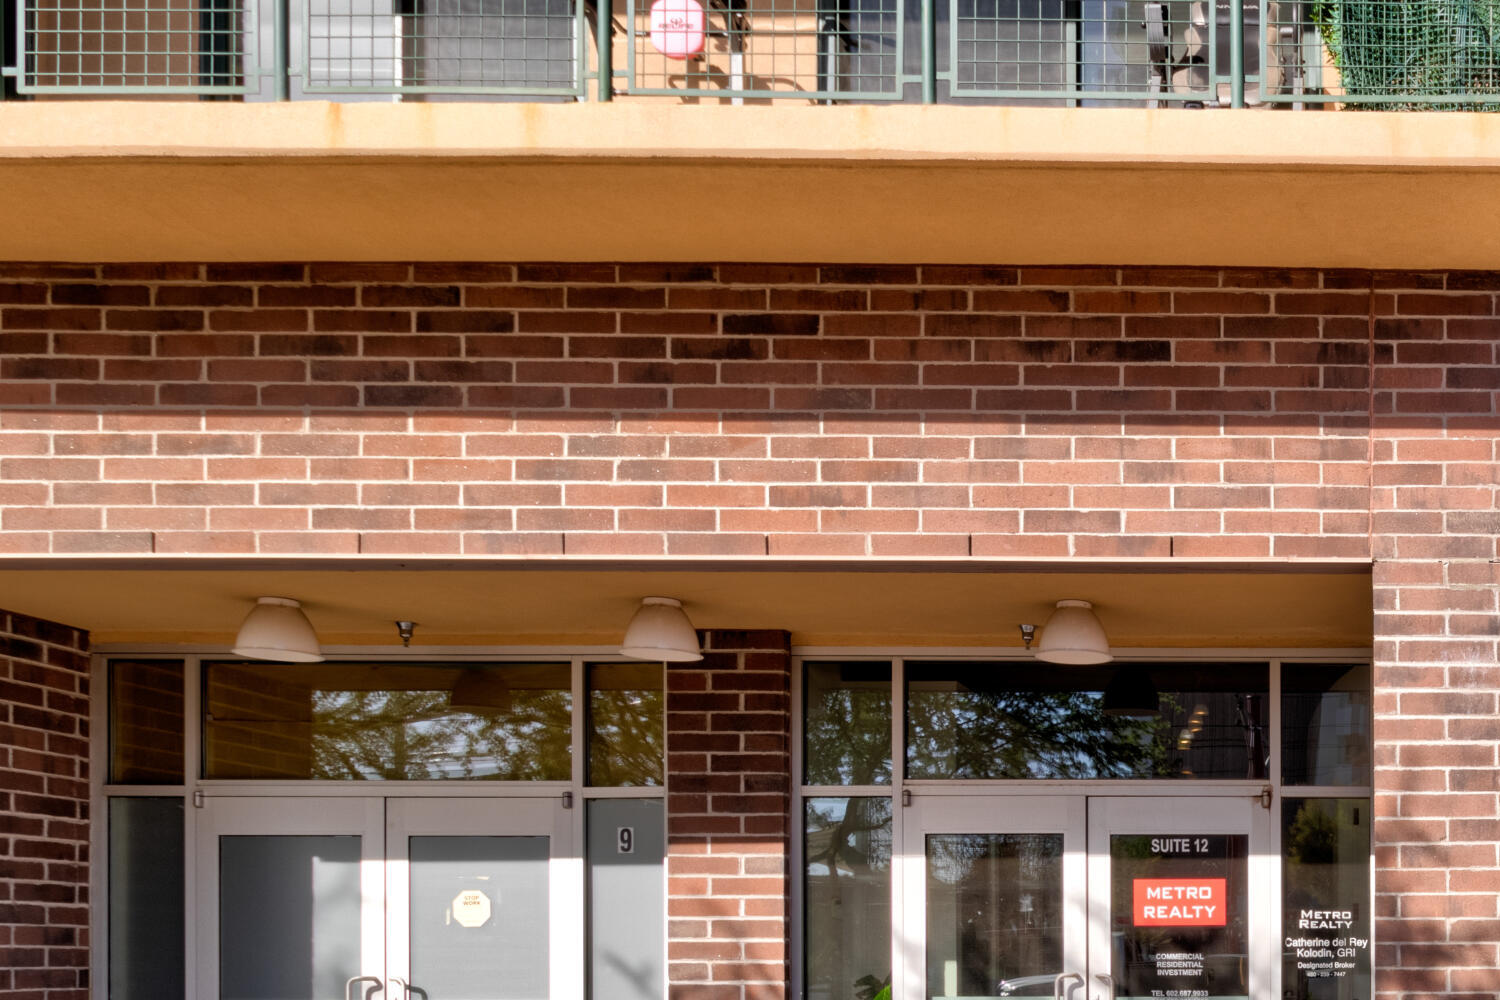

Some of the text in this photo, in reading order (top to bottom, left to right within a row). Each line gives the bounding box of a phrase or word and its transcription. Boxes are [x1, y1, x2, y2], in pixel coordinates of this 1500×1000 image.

[620, 828, 632, 852] 9
[1152, 839, 1209, 852] SUITE 12
[1147, 887, 1212, 899] METRO
[1144, 906, 1216, 918] REALTY
[1301, 910, 1351, 919] METRO
[1299, 920, 1352, 929] REALTY
[1285, 938, 1368, 948] Catherine del Rey
[1297, 948, 1356, 958] Kolodin, GRI
